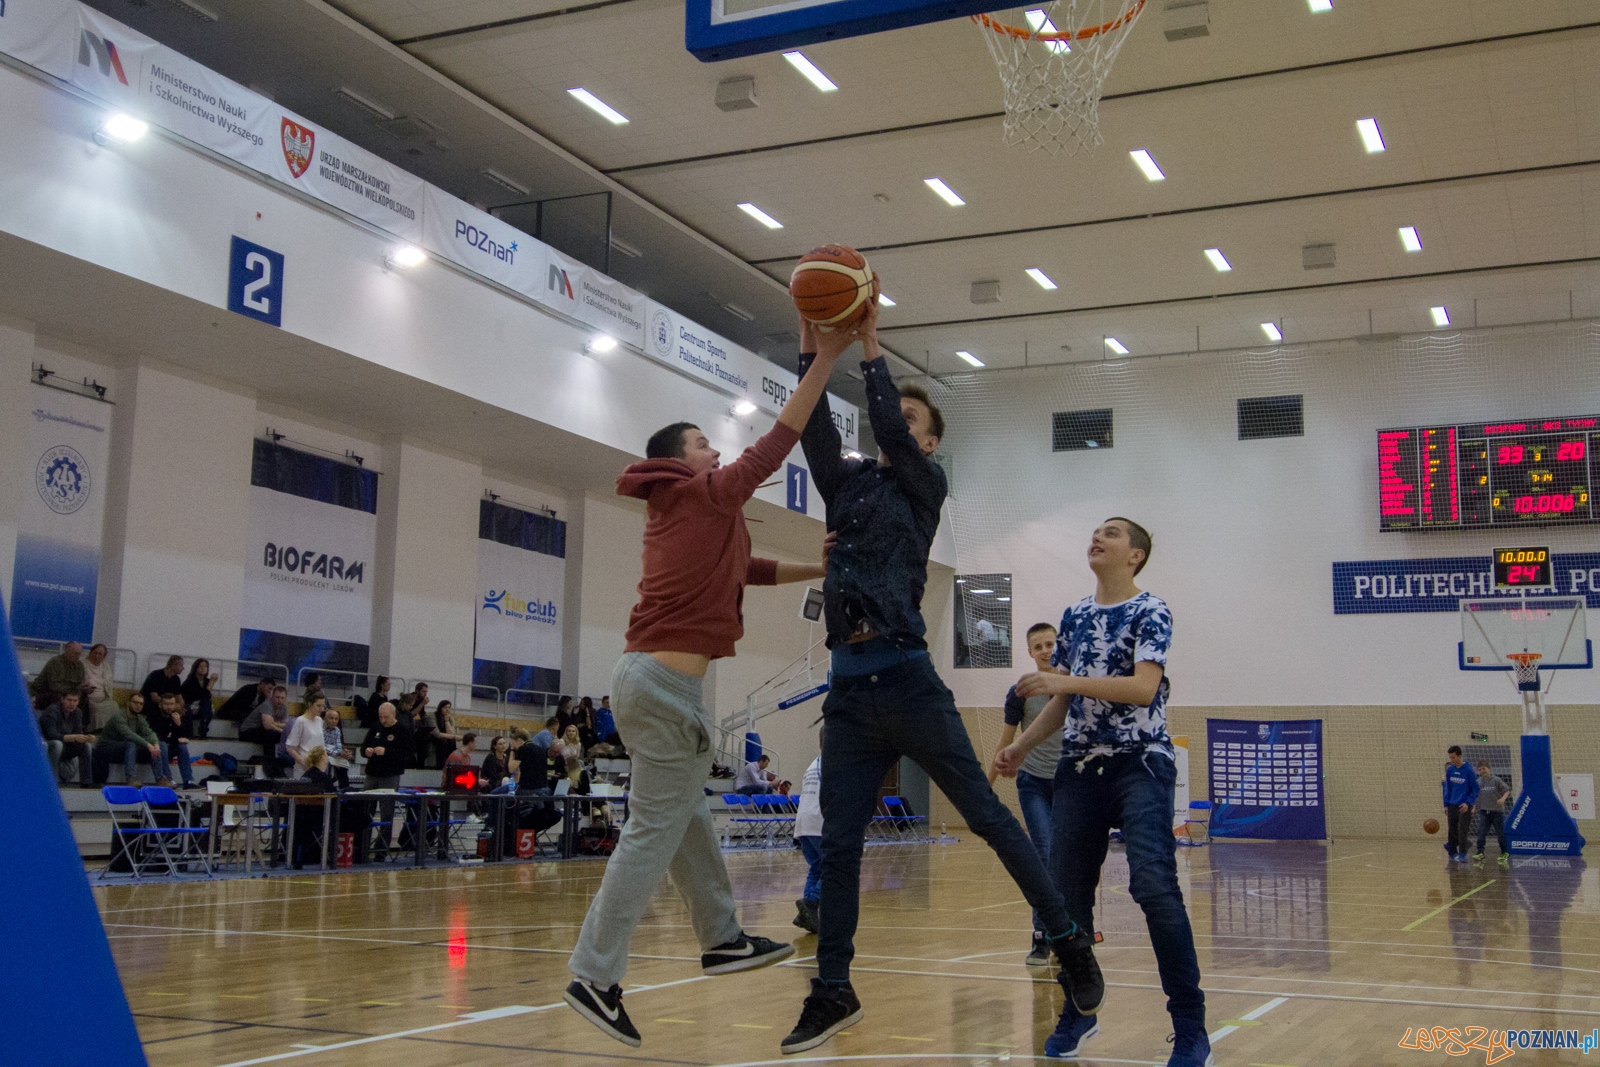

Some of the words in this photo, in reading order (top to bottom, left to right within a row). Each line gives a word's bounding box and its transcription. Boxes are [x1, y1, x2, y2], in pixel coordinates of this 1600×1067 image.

[151, 64, 216, 106] Ministerstwo
[218, 98, 246, 120] Nauki
[149, 81, 153, 93] i
[155, 84, 215, 124] Szkolnictwa
[217, 114, 264, 146] Wyższego
[320, 150, 340, 170] URZĄD
[341, 161, 390, 194] MARSZAŁKOWSKI
[320, 164, 363, 195] WOJEWÓDZTWA
[364, 186, 415, 221] WIELKOPOLSKIEGO
[243, 251, 271, 314] 2
[583, 282, 617, 305] Ministerstwo
[617, 298, 633, 313] Nauki
[585, 295, 617, 318] Szkolnictwa
[680, 325, 706, 350] Centrum
[707, 339, 726, 360] Sportu
[679, 345, 714, 374] Politechniki
[715, 363, 748, 393] Poznańskiej
[1498, 446, 1524, 464] 33
[1535, 452, 1541, 461] 3
[1557, 442, 1585, 461] 20
[794, 471, 802, 508] 1
[1493, 497, 1500, 506] 0
[1580, 493, 1588, 502] 0
[264, 542, 364, 584] BIOFARM
[1508, 565, 1538, 583] 24
[270, 572, 290, 583] POLSKI
[292, 577, 330, 589] PRODUCENT
[332, 584, 355, 593] LEKÓW
[504, 592, 557, 617] funclub
[505, 609, 523, 619] biuro
[525, 614, 556, 626] podróży
[1511, 795, 1532, 830] HYDROPLAY
[520, 832, 533, 851] 5
[1511, 840, 1570, 849] SPORTSYSTEM
